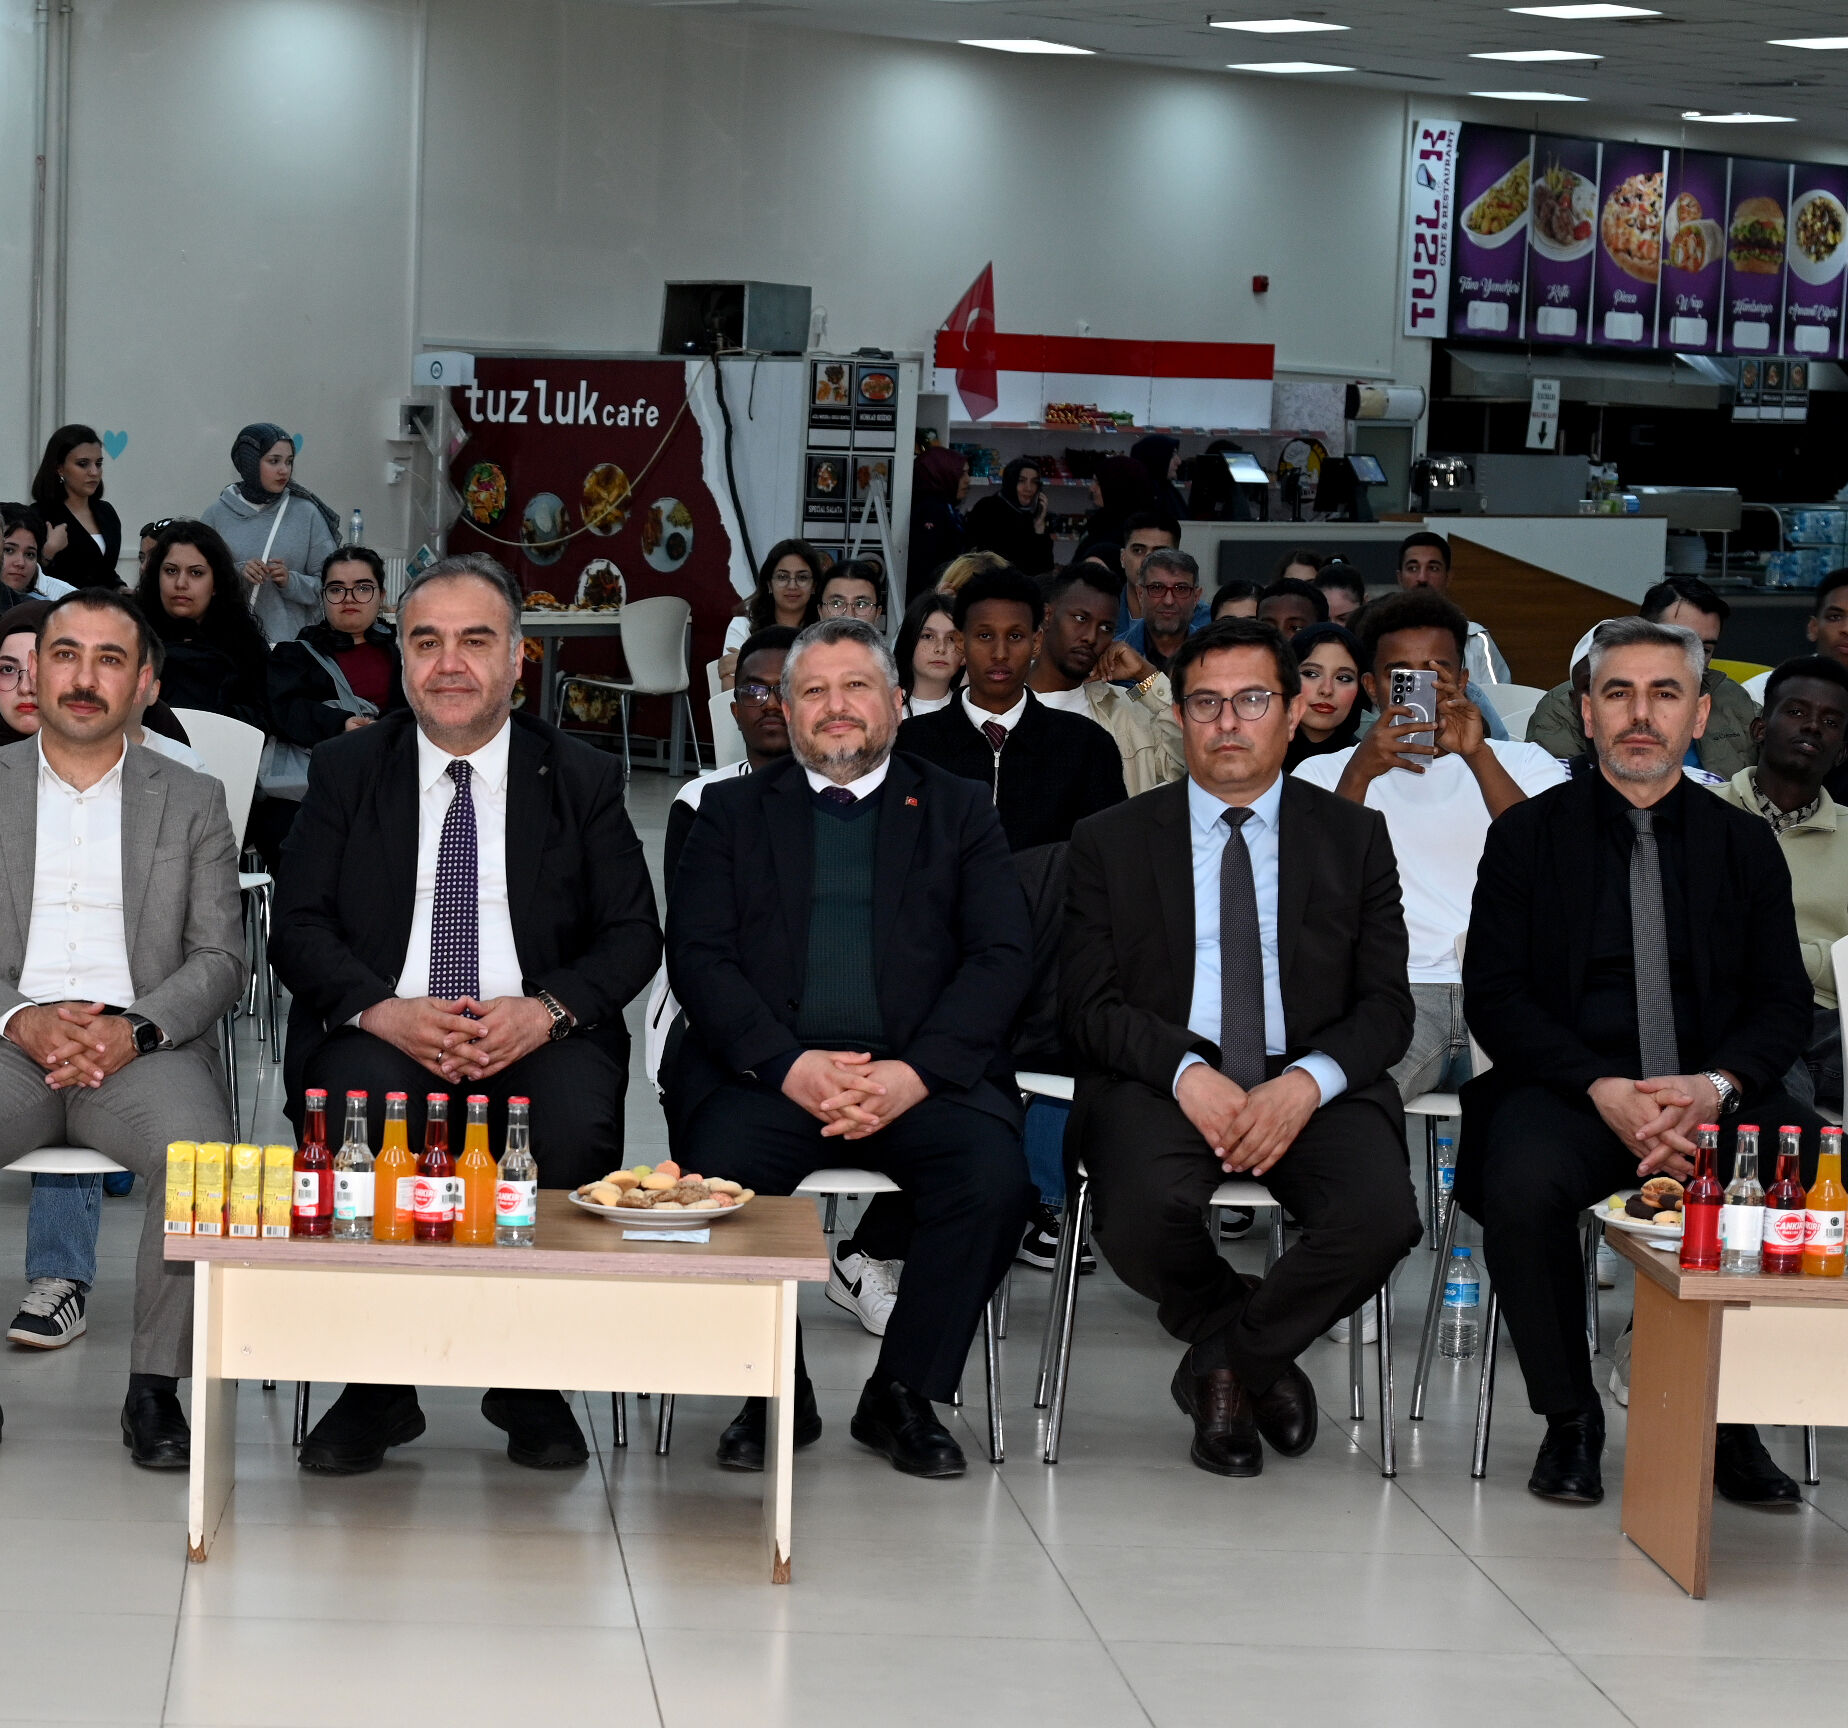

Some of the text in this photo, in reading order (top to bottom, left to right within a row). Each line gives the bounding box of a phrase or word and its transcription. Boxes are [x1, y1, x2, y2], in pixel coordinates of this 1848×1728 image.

[1442, 129, 1456, 219] RESTAURANT
[1440, 234, 1448, 267] CAFE
[465, 378, 660, 427] tuzluk cafe
